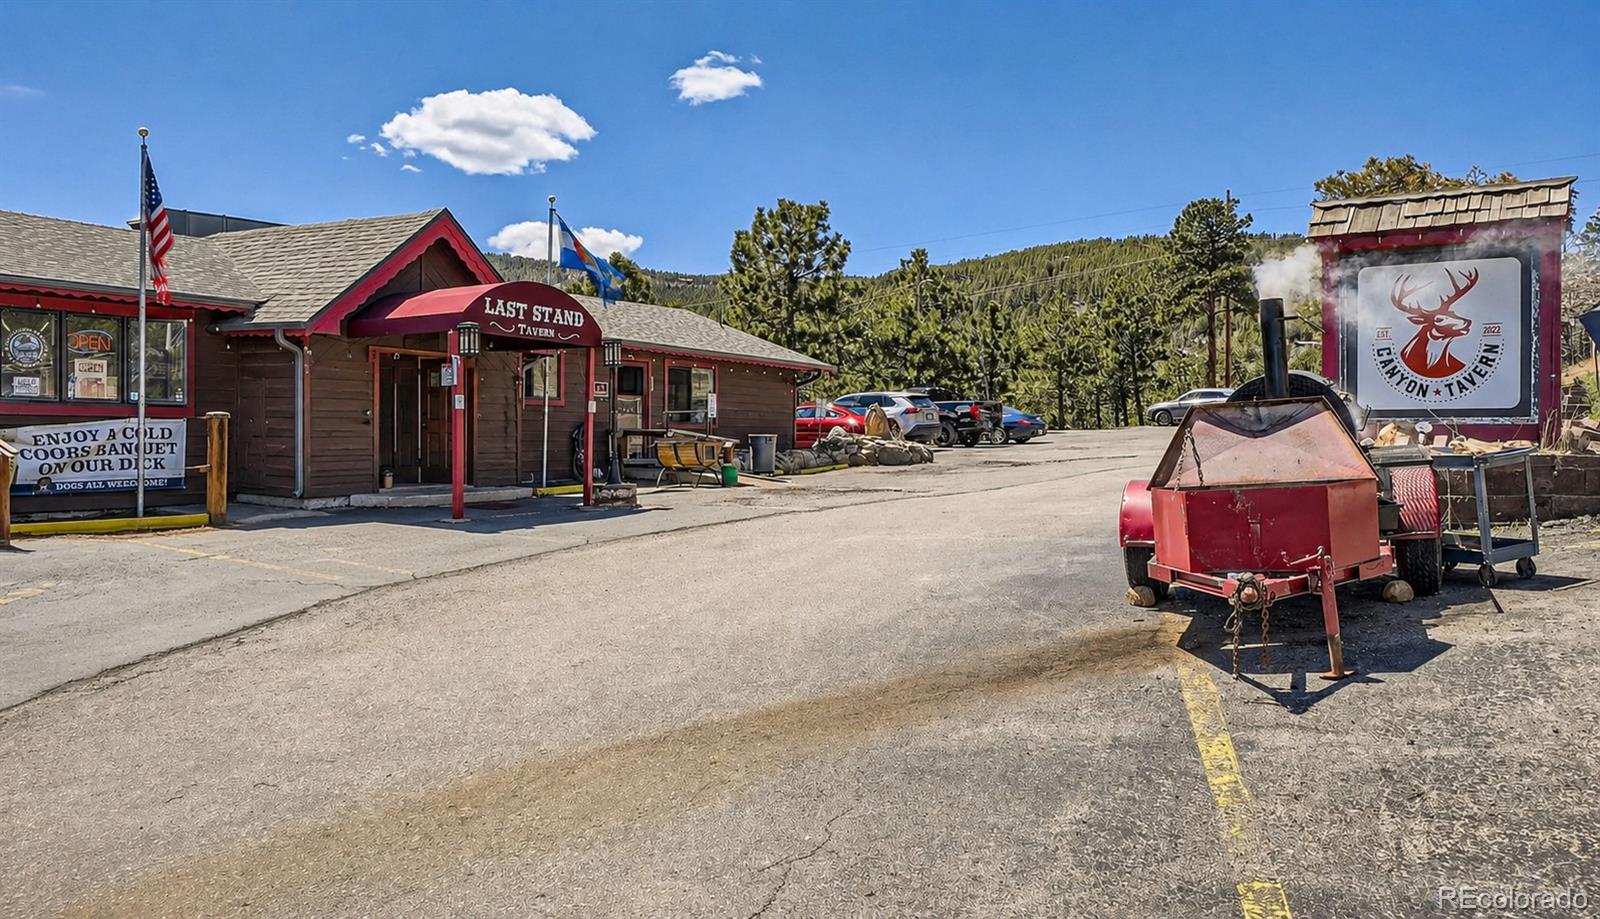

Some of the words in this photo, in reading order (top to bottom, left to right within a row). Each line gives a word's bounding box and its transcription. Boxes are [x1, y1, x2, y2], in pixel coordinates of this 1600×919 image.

[484, 297, 528, 319] LAST
[532, 305, 584, 327] STAND
[1376, 330, 1391, 338] EST.
[1483, 326, 1501, 334] 2022
[67, 332, 112, 352] OPEN
[1376, 347, 1430, 398] CANYON
[1444, 343, 1500, 397] TAVERN
[32, 429, 100, 446] ENJOY
[106, 428, 117, 441] A
[20, 445, 91, 461] COORS
[38, 461, 68, 476] ON
[71, 458, 114, 474] OUR
[55, 481, 84, 491] DOGS
[85, 480, 105, 490] ALL
